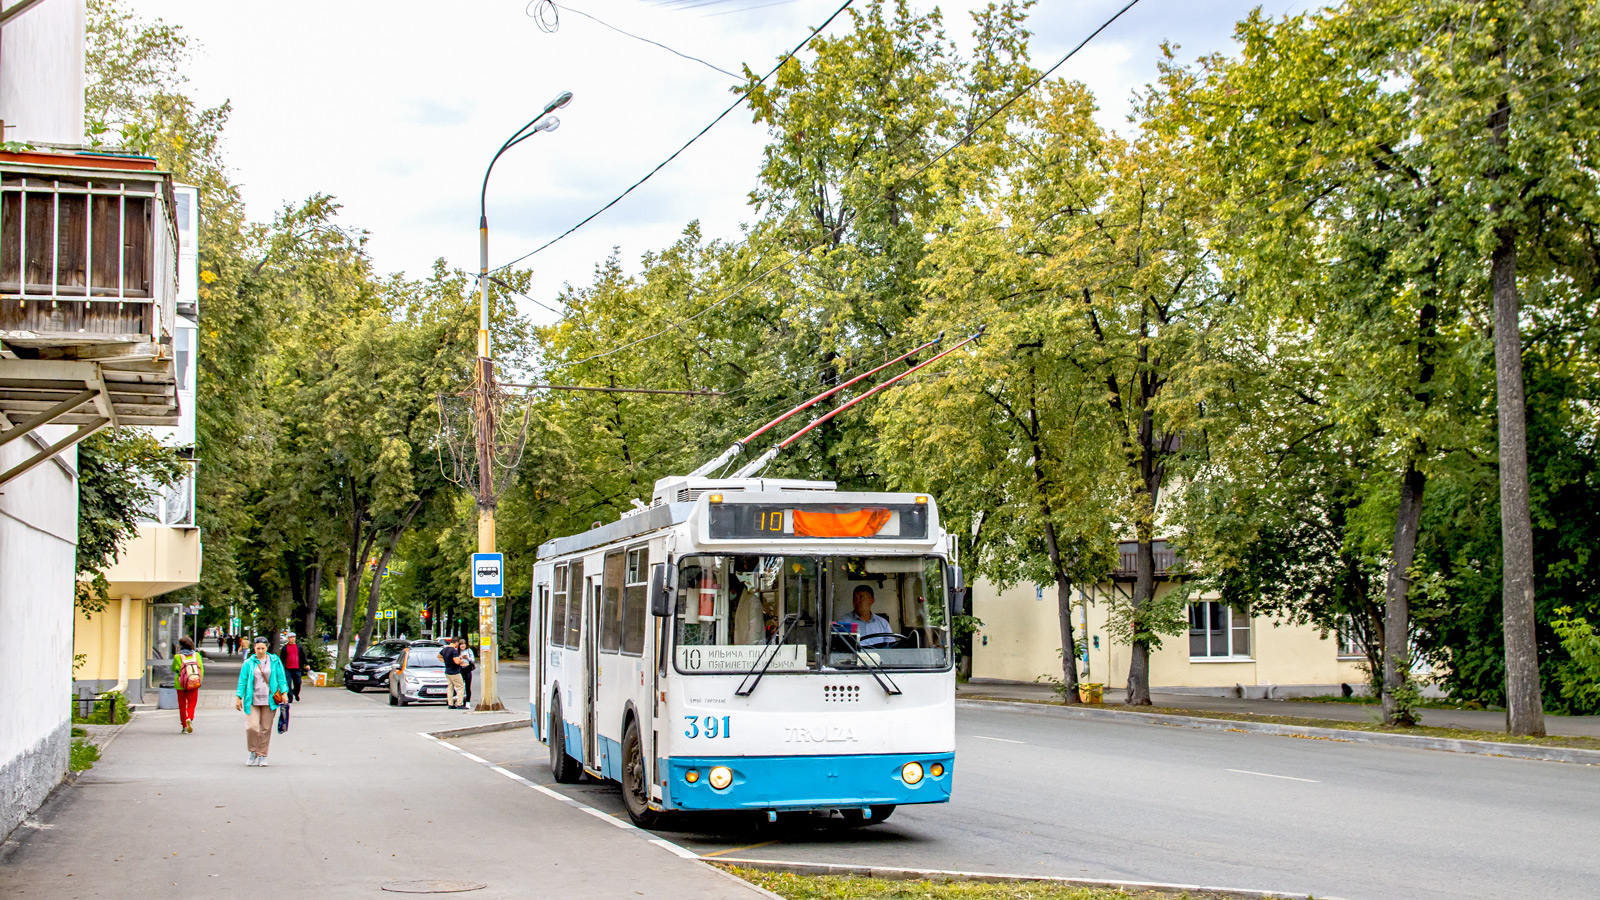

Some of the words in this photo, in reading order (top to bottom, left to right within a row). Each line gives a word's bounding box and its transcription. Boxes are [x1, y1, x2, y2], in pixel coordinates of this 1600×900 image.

[761, 511, 783, 531] 10
[682, 649, 701, 670] 10
[684, 715, 731, 739] 391
